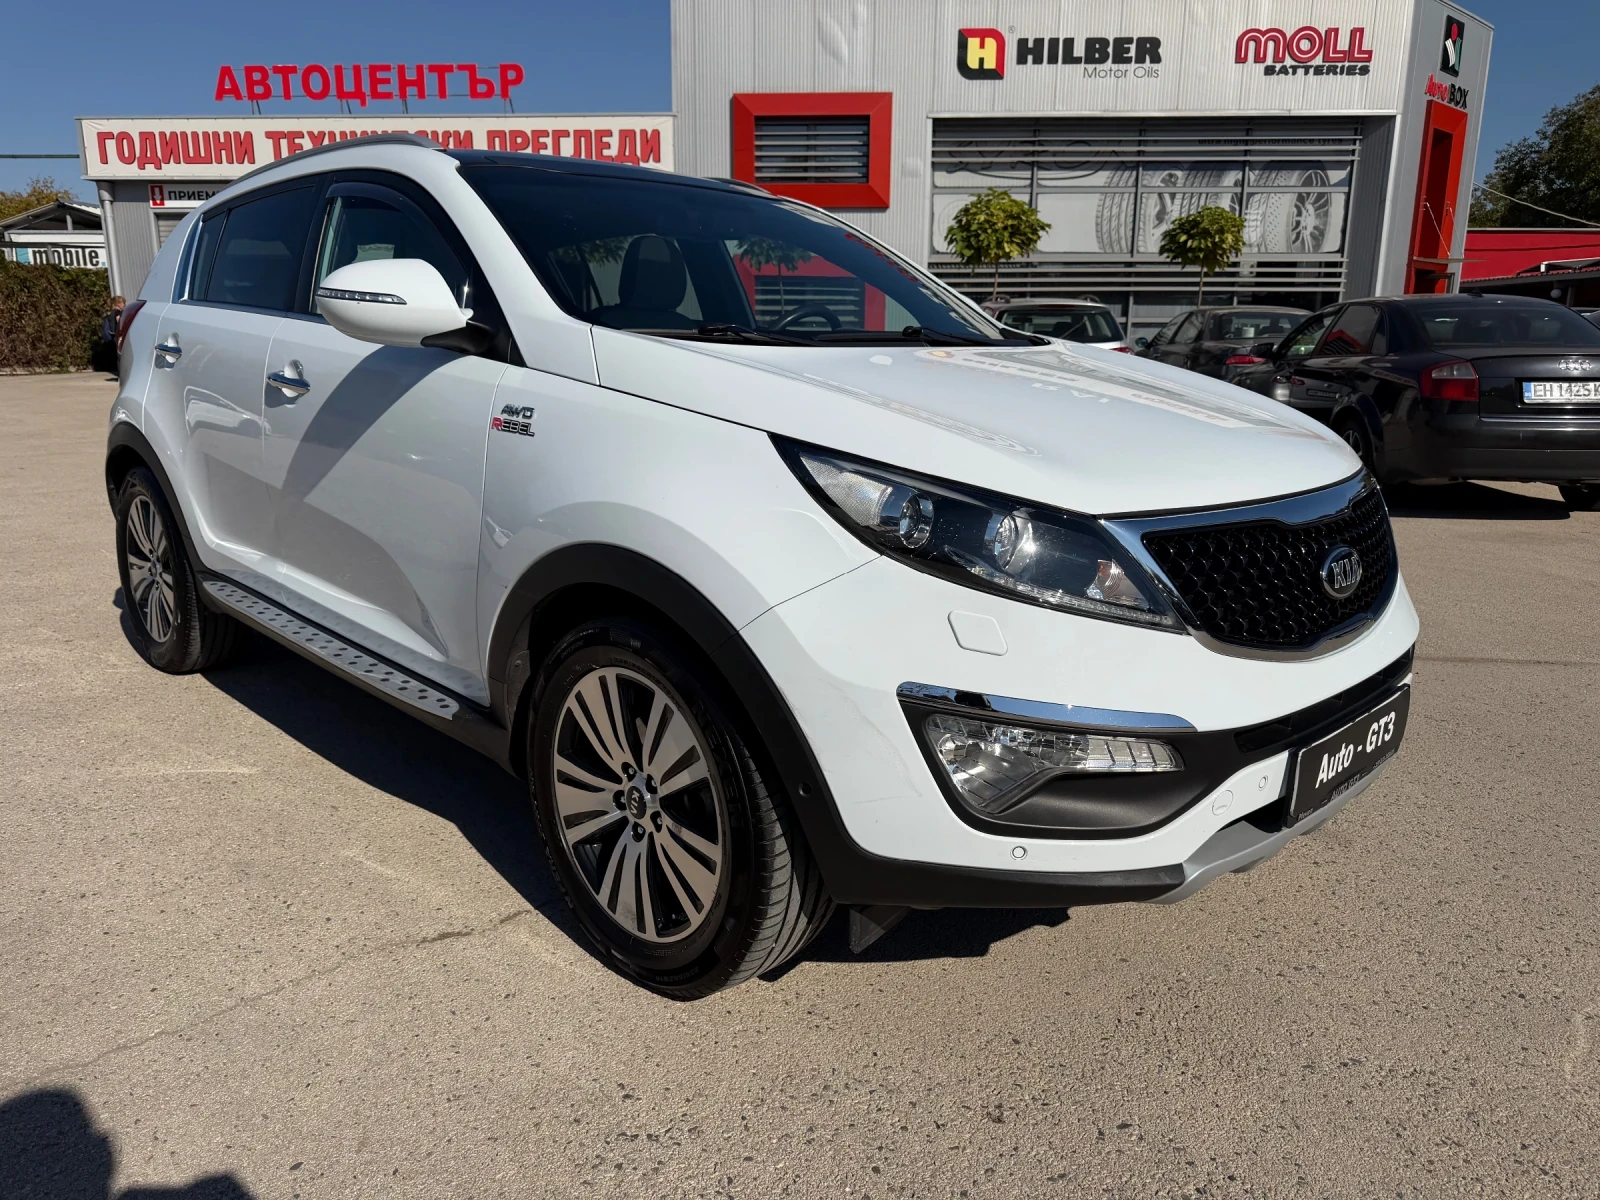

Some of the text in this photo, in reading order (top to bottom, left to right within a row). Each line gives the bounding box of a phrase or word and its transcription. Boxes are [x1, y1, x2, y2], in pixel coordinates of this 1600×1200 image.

[1016, 36, 1162, 65] HILBER
[1082, 66, 1160, 79] Motor Oils
[1263, 65, 1371, 76] BATTERIES
[214, 63, 525, 107] АВТОЦЕНТЪР
[1447, 82, 1469, 109] BOX
[96, 131, 256, 170] ГОДИШНИ
[486, 128, 661, 166] ПРЕГЛЕДИ
[491, 416, 535, 437] REBEL
[1315, 742, 1354, 789] Auto
[1366, 711, 1396, 753] GT3
